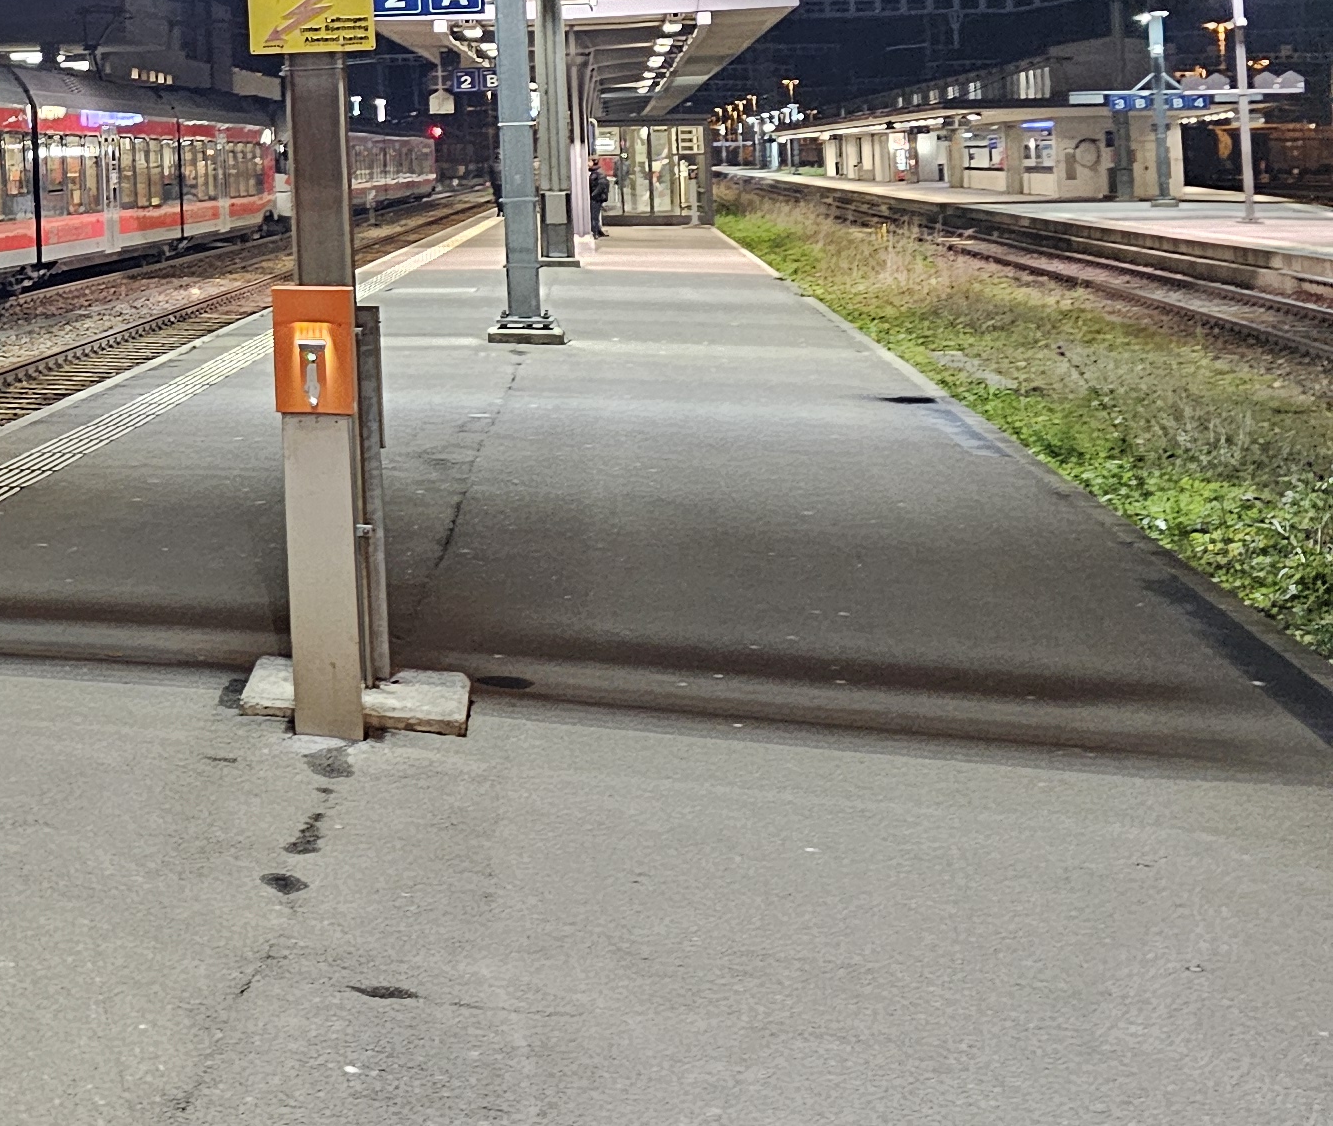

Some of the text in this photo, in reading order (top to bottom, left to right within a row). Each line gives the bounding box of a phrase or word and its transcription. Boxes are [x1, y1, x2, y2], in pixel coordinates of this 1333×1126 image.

[460, 75, 472, 88] 2
[486, 75, 499, 87] B
[1114, 99, 1125, 109] 3
[1194, 97, 1204, 107] 4
